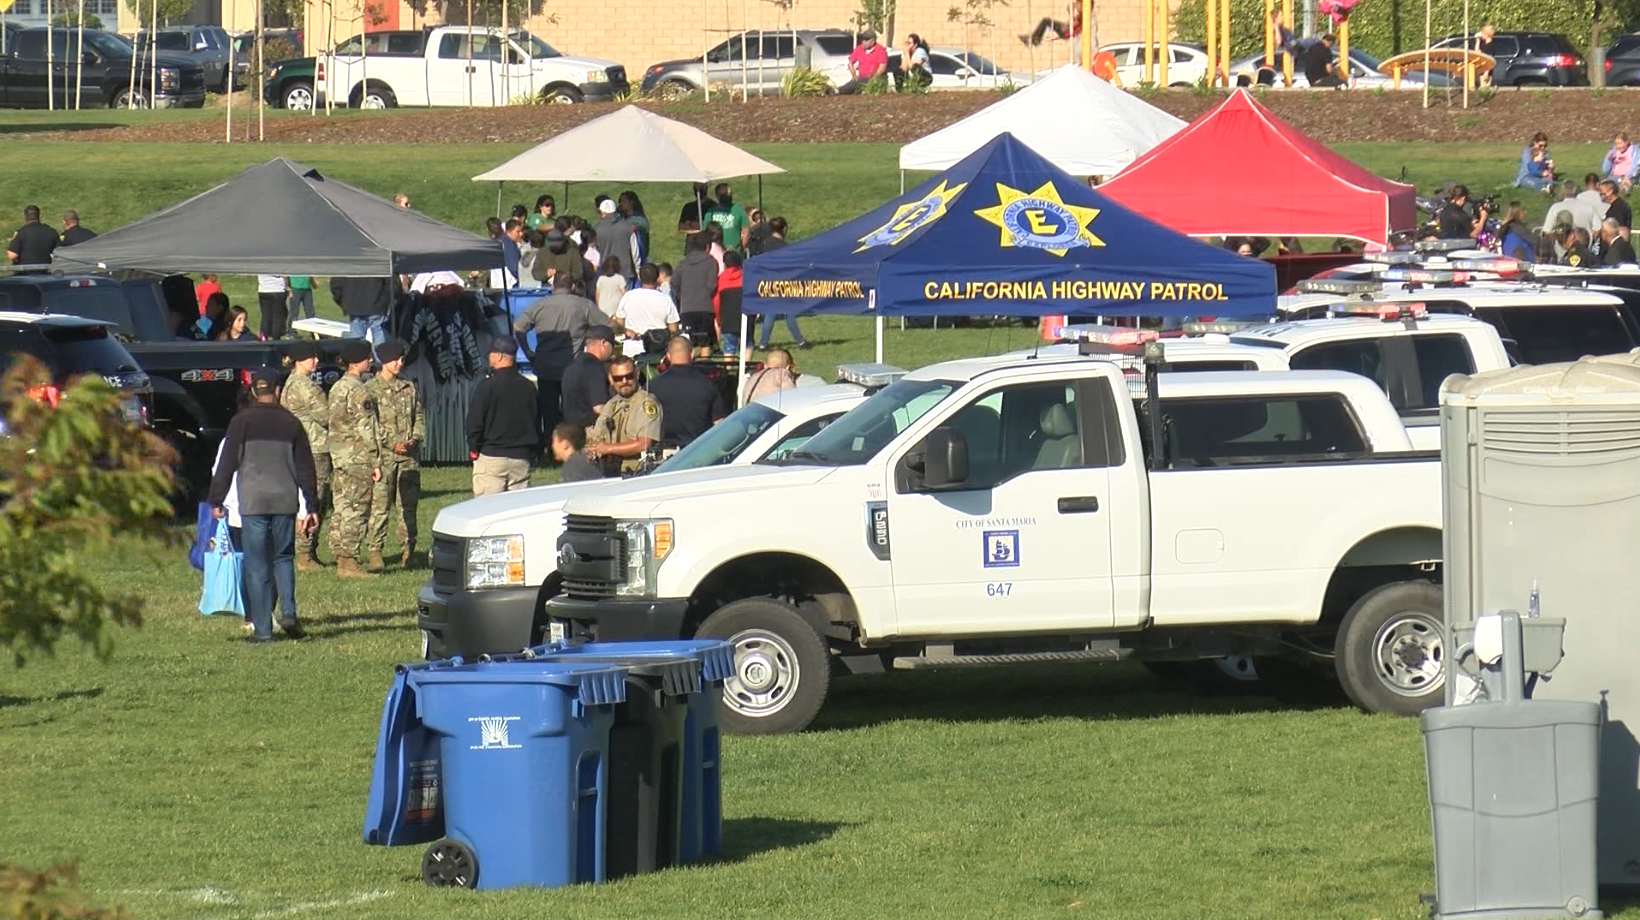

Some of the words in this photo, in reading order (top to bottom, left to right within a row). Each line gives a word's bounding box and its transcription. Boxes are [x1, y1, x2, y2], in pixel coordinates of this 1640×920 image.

[1021, 200, 1065, 215] HIGHWAY
[1025, 209, 1059, 234] E
[757, 280, 804, 298] CALIFORNIA
[804, 280, 835, 298] HIGHWAY
[835, 281, 865, 299] PATROL
[924, 281, 1047, 299] CALIFORNIA
[1052, 281, 1145, 299] HIGHWAY
[1151, 282, 1228, 300] PATROL
[956, 519, 973, 529] CITY
[975, 519, 985, 528] OF
[987, 518, 1010, 527] SANTA
[1012, 517, 1037, 526] MARIA
[987, 582, 1013, 597] 647
